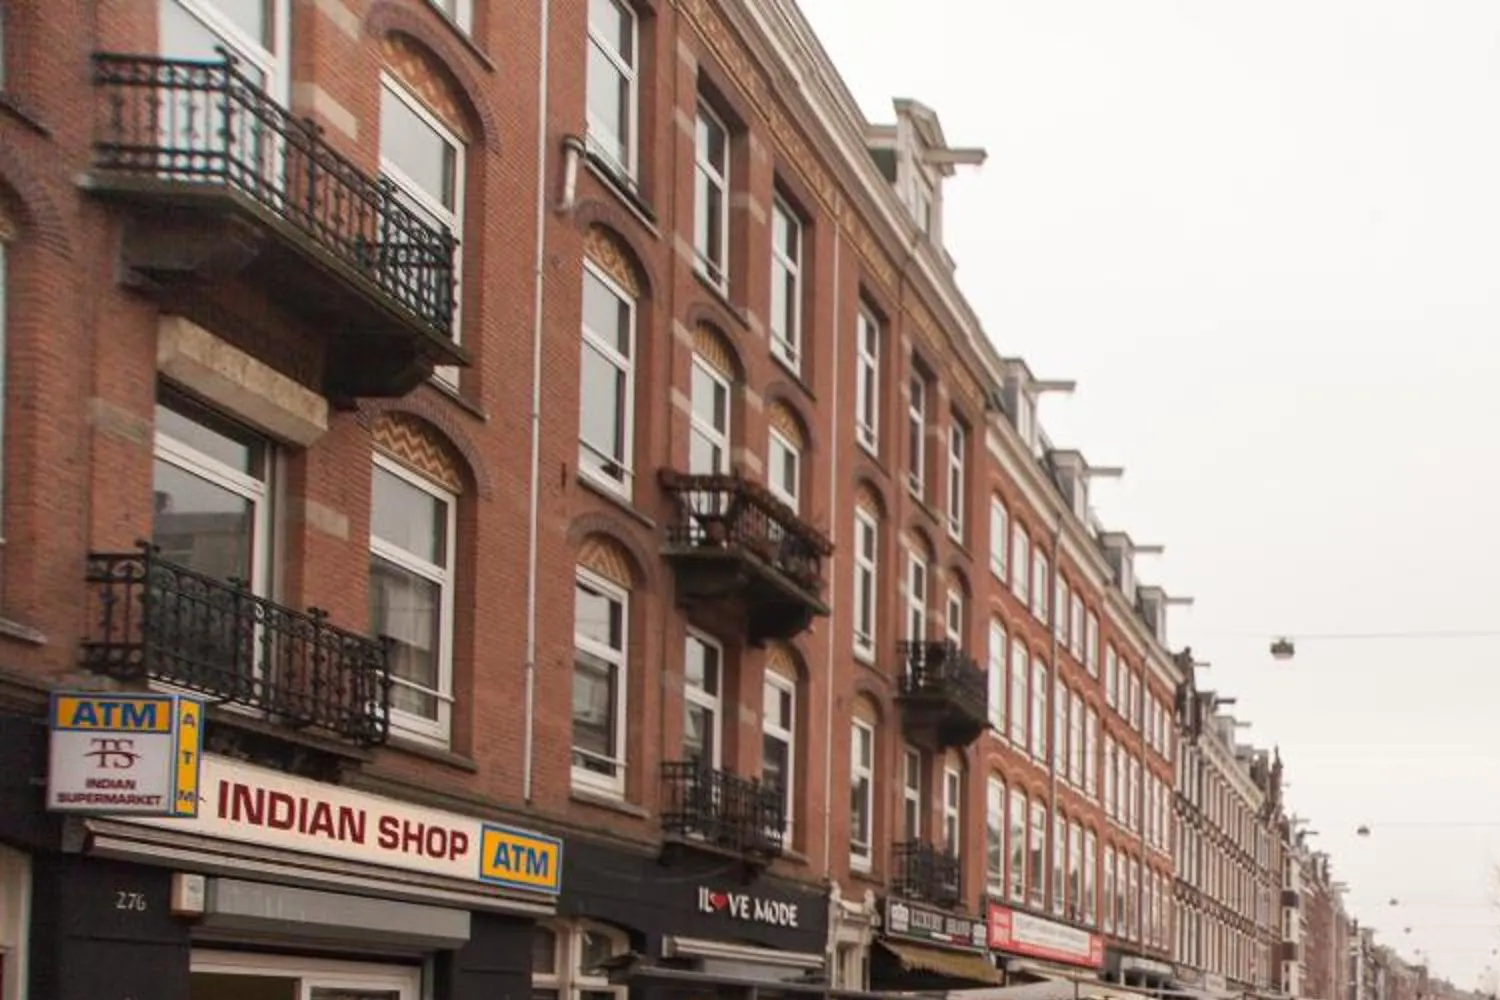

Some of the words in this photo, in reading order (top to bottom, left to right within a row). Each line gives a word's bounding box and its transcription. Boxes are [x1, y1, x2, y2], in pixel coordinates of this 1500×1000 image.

[72, 702, 156, 727] ATM
[86, 778, 136, 789] INDIAN
[57, 792, 162, 806] SUPERMARKET
[216, 779, 367, 845] INDIAN
[376, 815, 470, 862] SHOP
[491, 841, 549, 878] ATM
[116, 891, 146, 911] 276
[753, 898, 799, 928] MODE
